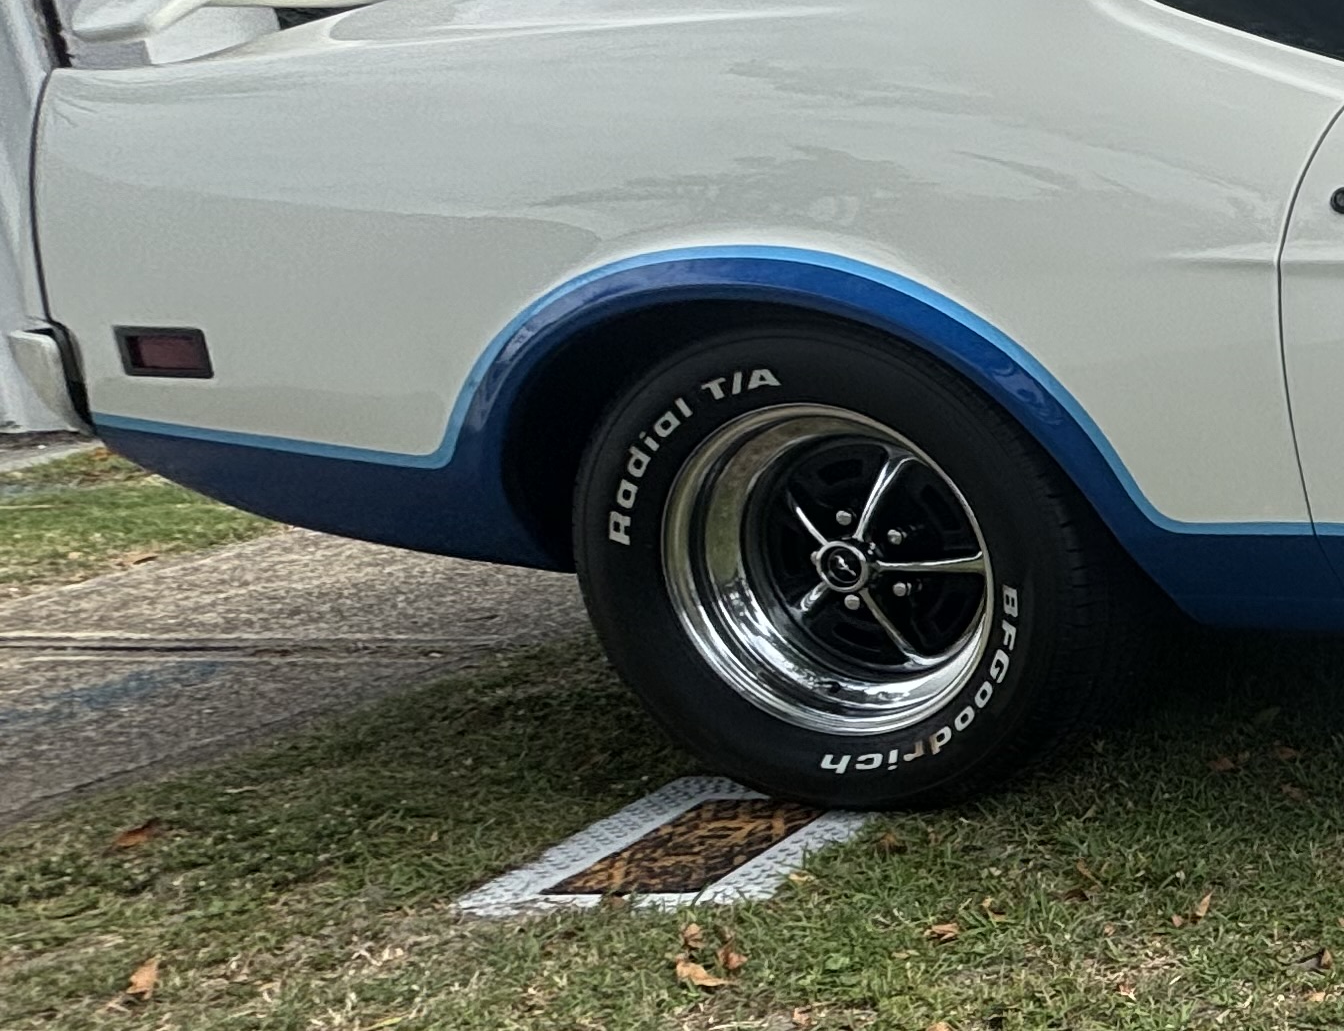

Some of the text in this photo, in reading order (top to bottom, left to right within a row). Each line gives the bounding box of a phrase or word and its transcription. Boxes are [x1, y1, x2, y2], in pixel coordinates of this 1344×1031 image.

[608, 368, 781, 546] Radial T/A
[820, 583, 1018, 774] BFGoodrich
